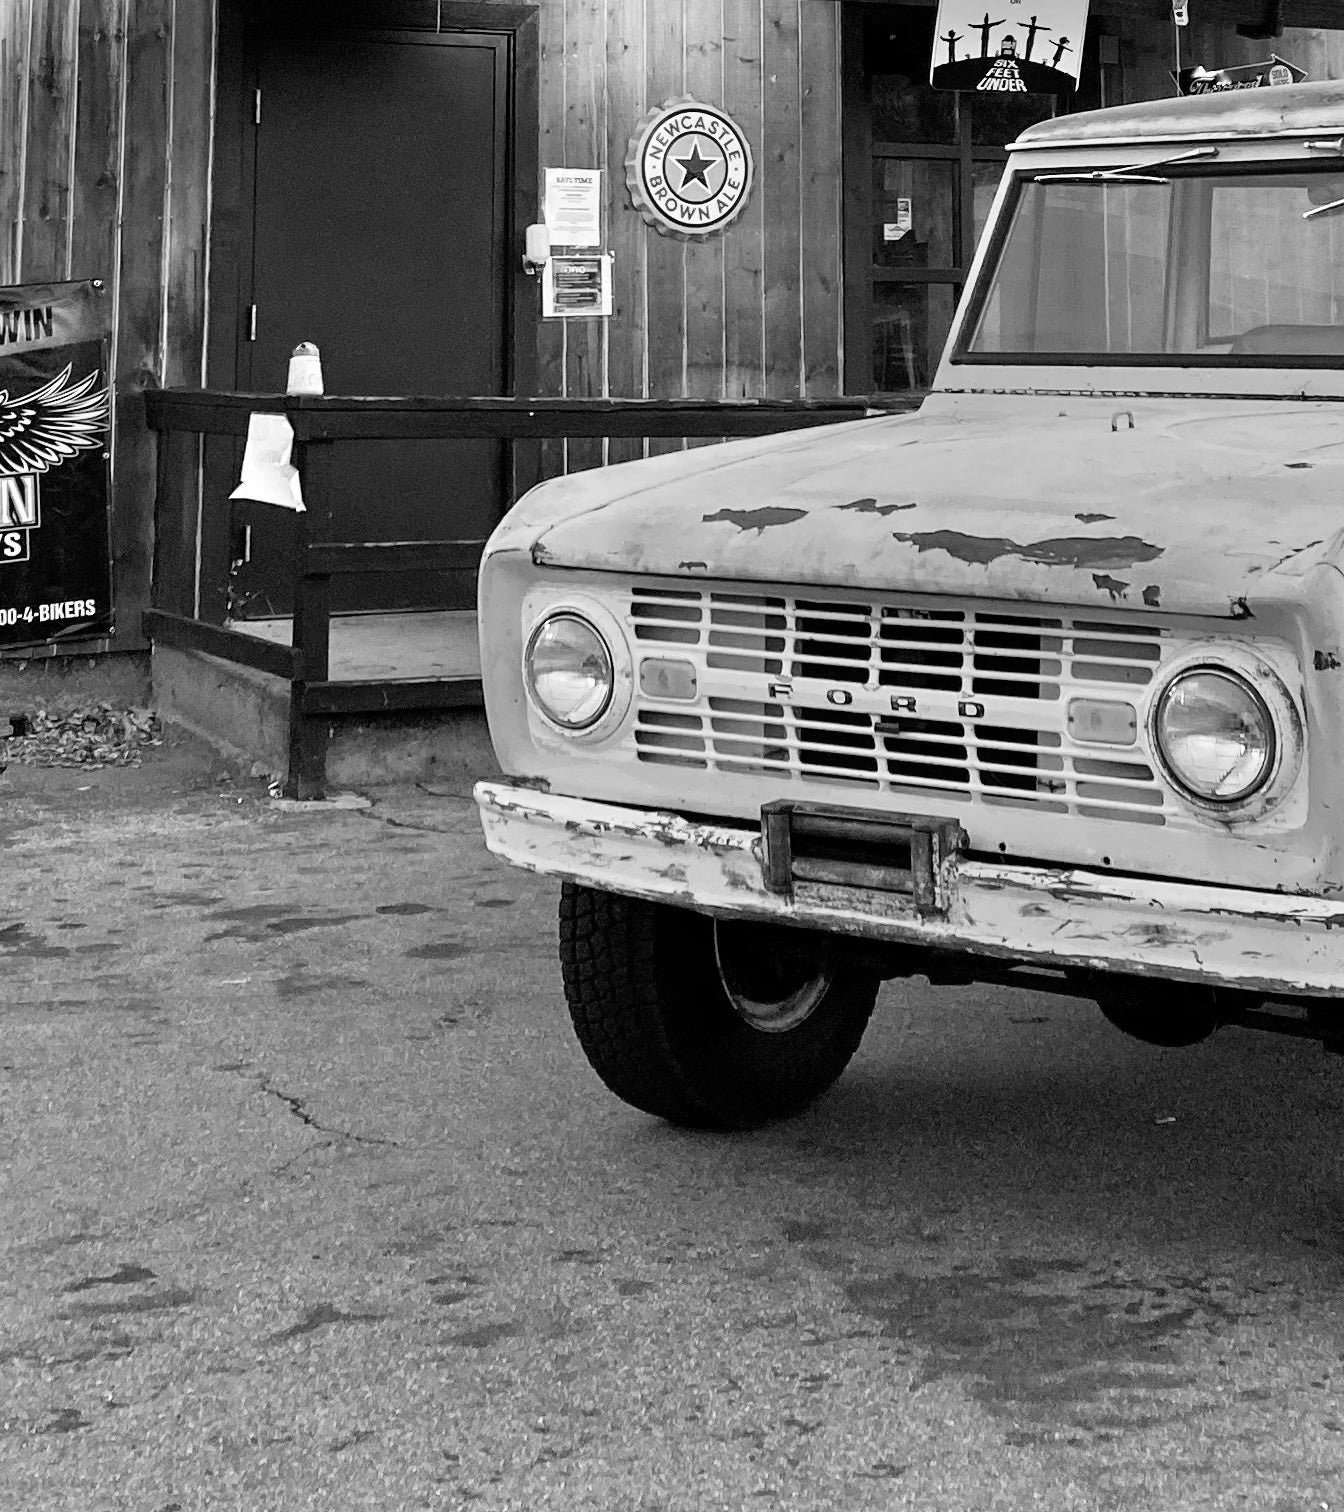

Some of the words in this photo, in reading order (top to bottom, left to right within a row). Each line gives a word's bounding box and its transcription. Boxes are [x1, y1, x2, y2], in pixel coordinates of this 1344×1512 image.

[986, 68, 1020, 78] FEET
[994, 59, 1019, 69] SIX
[976, 77, 1028, 92] UNDER
[649, 116, 741, 162] NEWCASTLE
[649, 175, 710, 221] BROWN
[717, 179, 741, 214] ALE
[768, 682, 986, 719] FORD
